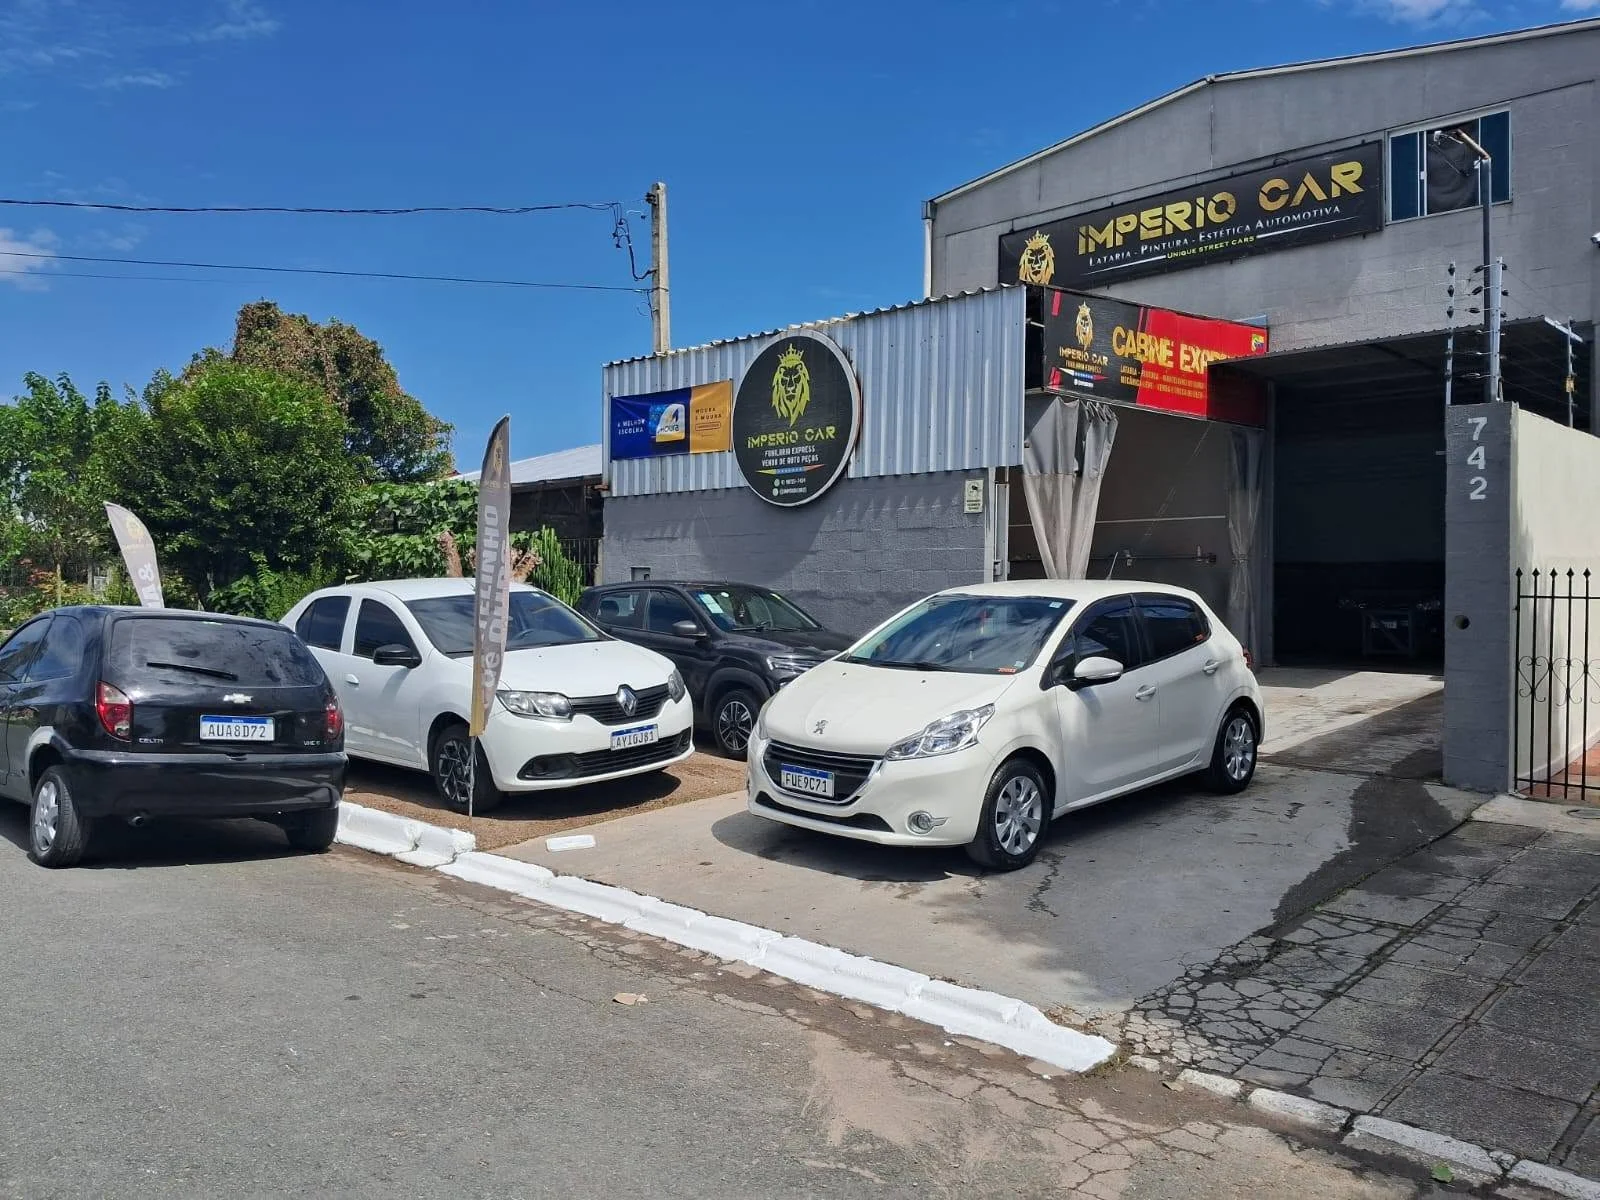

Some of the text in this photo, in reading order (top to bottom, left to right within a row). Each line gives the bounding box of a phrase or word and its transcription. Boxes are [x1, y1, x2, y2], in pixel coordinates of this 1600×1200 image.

[1078, 160, 1365, 256] IMPERIO CAR
[1167, 235, 1255, 259] UNIQUE STREET CARS
[1059, 345, 1109, 366] IMPERIO CAR
[747, 425, 836, 449] IMPERIO CAR
[208, 724, 267, 738] AUA8D72
[785, 772, 827, 793] FUE9C71
